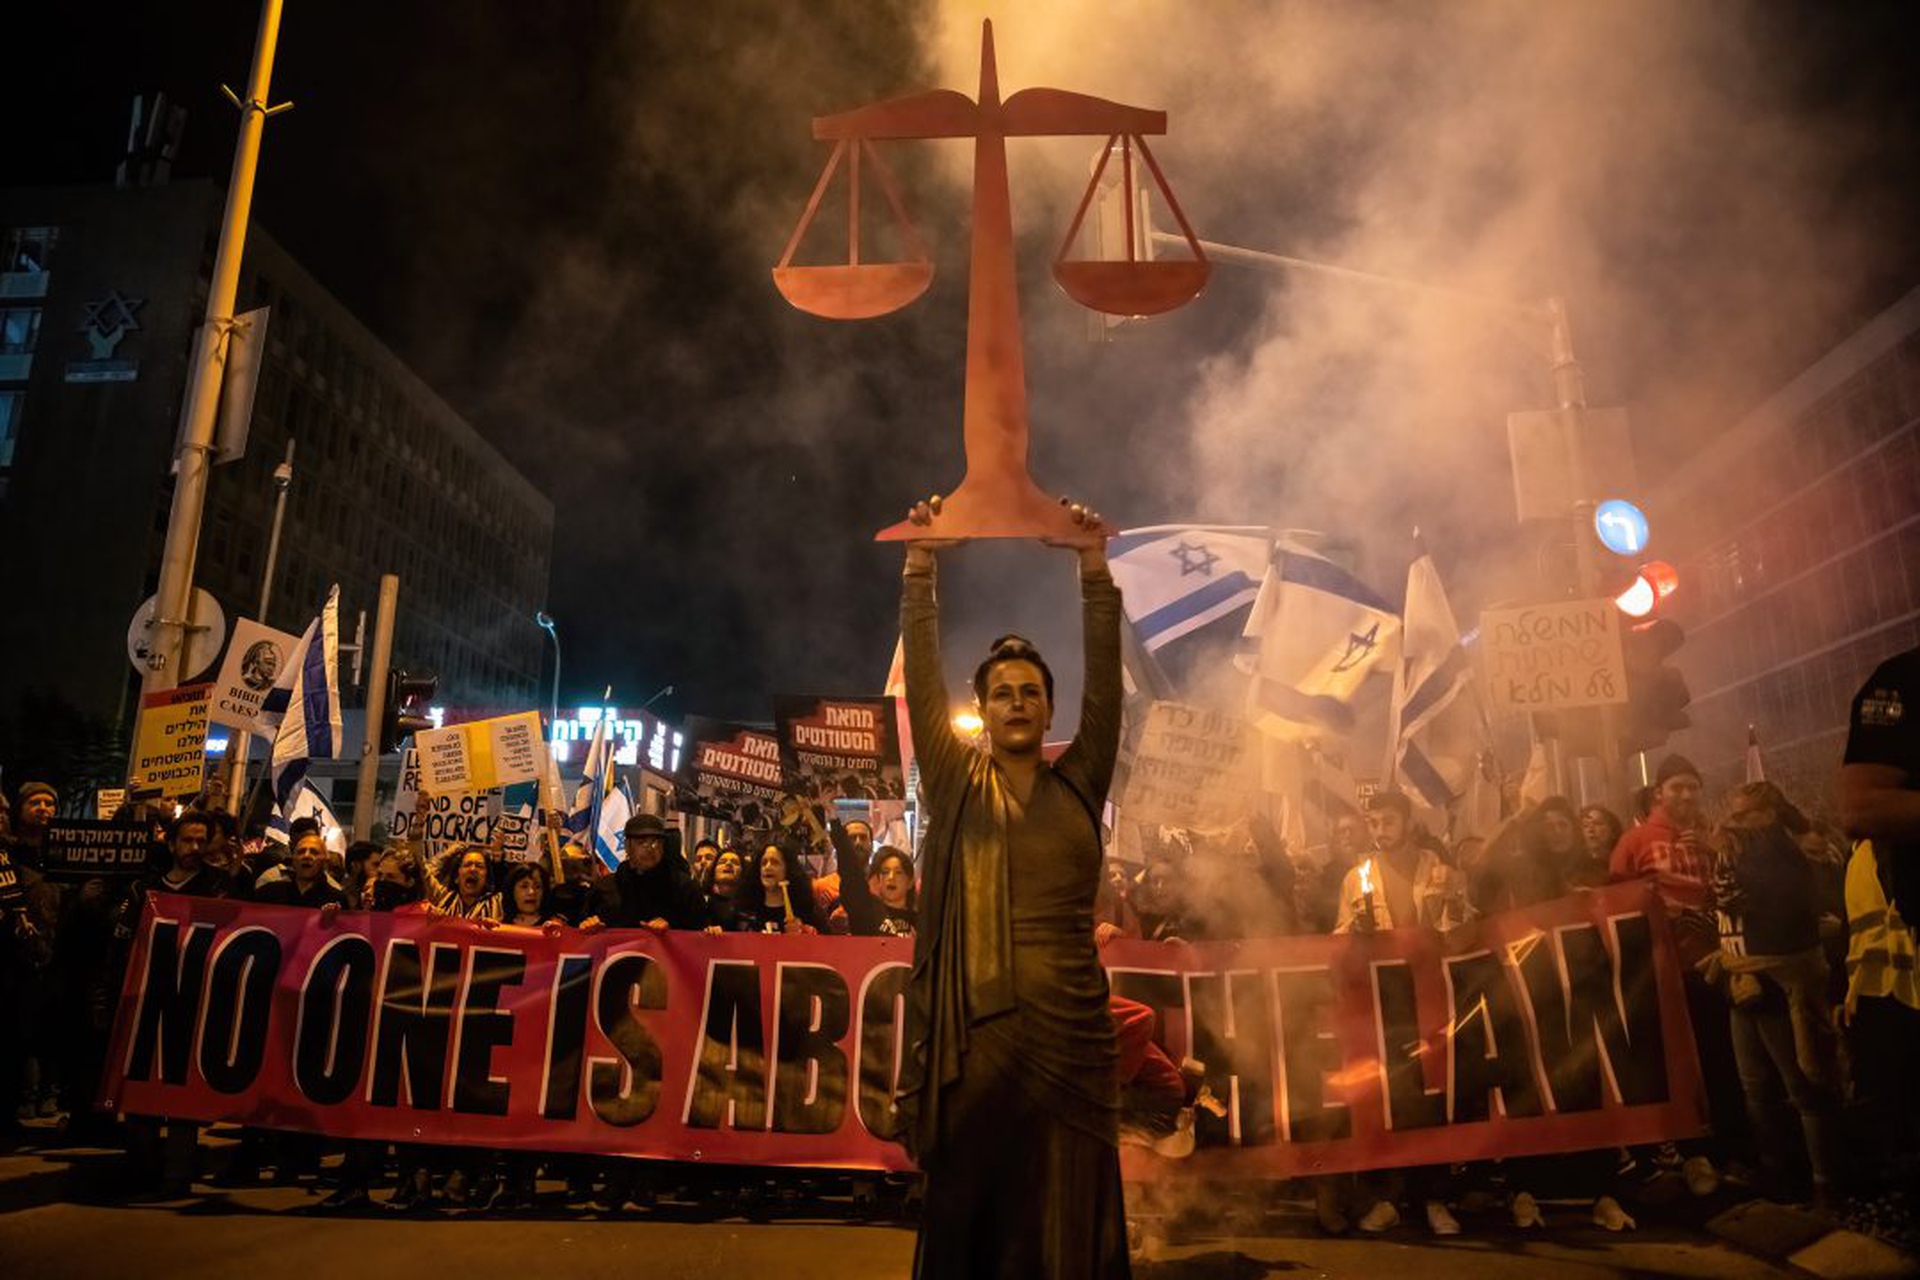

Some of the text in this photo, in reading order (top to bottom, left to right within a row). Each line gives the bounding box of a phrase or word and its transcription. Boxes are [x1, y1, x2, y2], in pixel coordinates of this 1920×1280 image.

[1494, 609, 1609, 645] ממשלת
[190, 704, 208, 716] את
[825, 706, 875, 728] מחאת
[164, 719, 207, 736] הילדים
[796, 724, 876, 751] הסטודנטים
[742, 737, 780, 761] חאת
[141, 749, 203, 769] מהשטחים
[147, 765, 201, 783] הכבושים
[427, 796, 488, 814] ND OF
[49, 827, 149, 846] אין דמוקרטיה
[66, 847, 147, 863] עם כיבוש
[124, 918, 283, 1094] NO
[293, 938, 527, 1115] ONE
[538, 951, 670, 1128] IS
[681, 958, 914, 1142] ABO
[1369, 911, 1672, 1131] LAW
